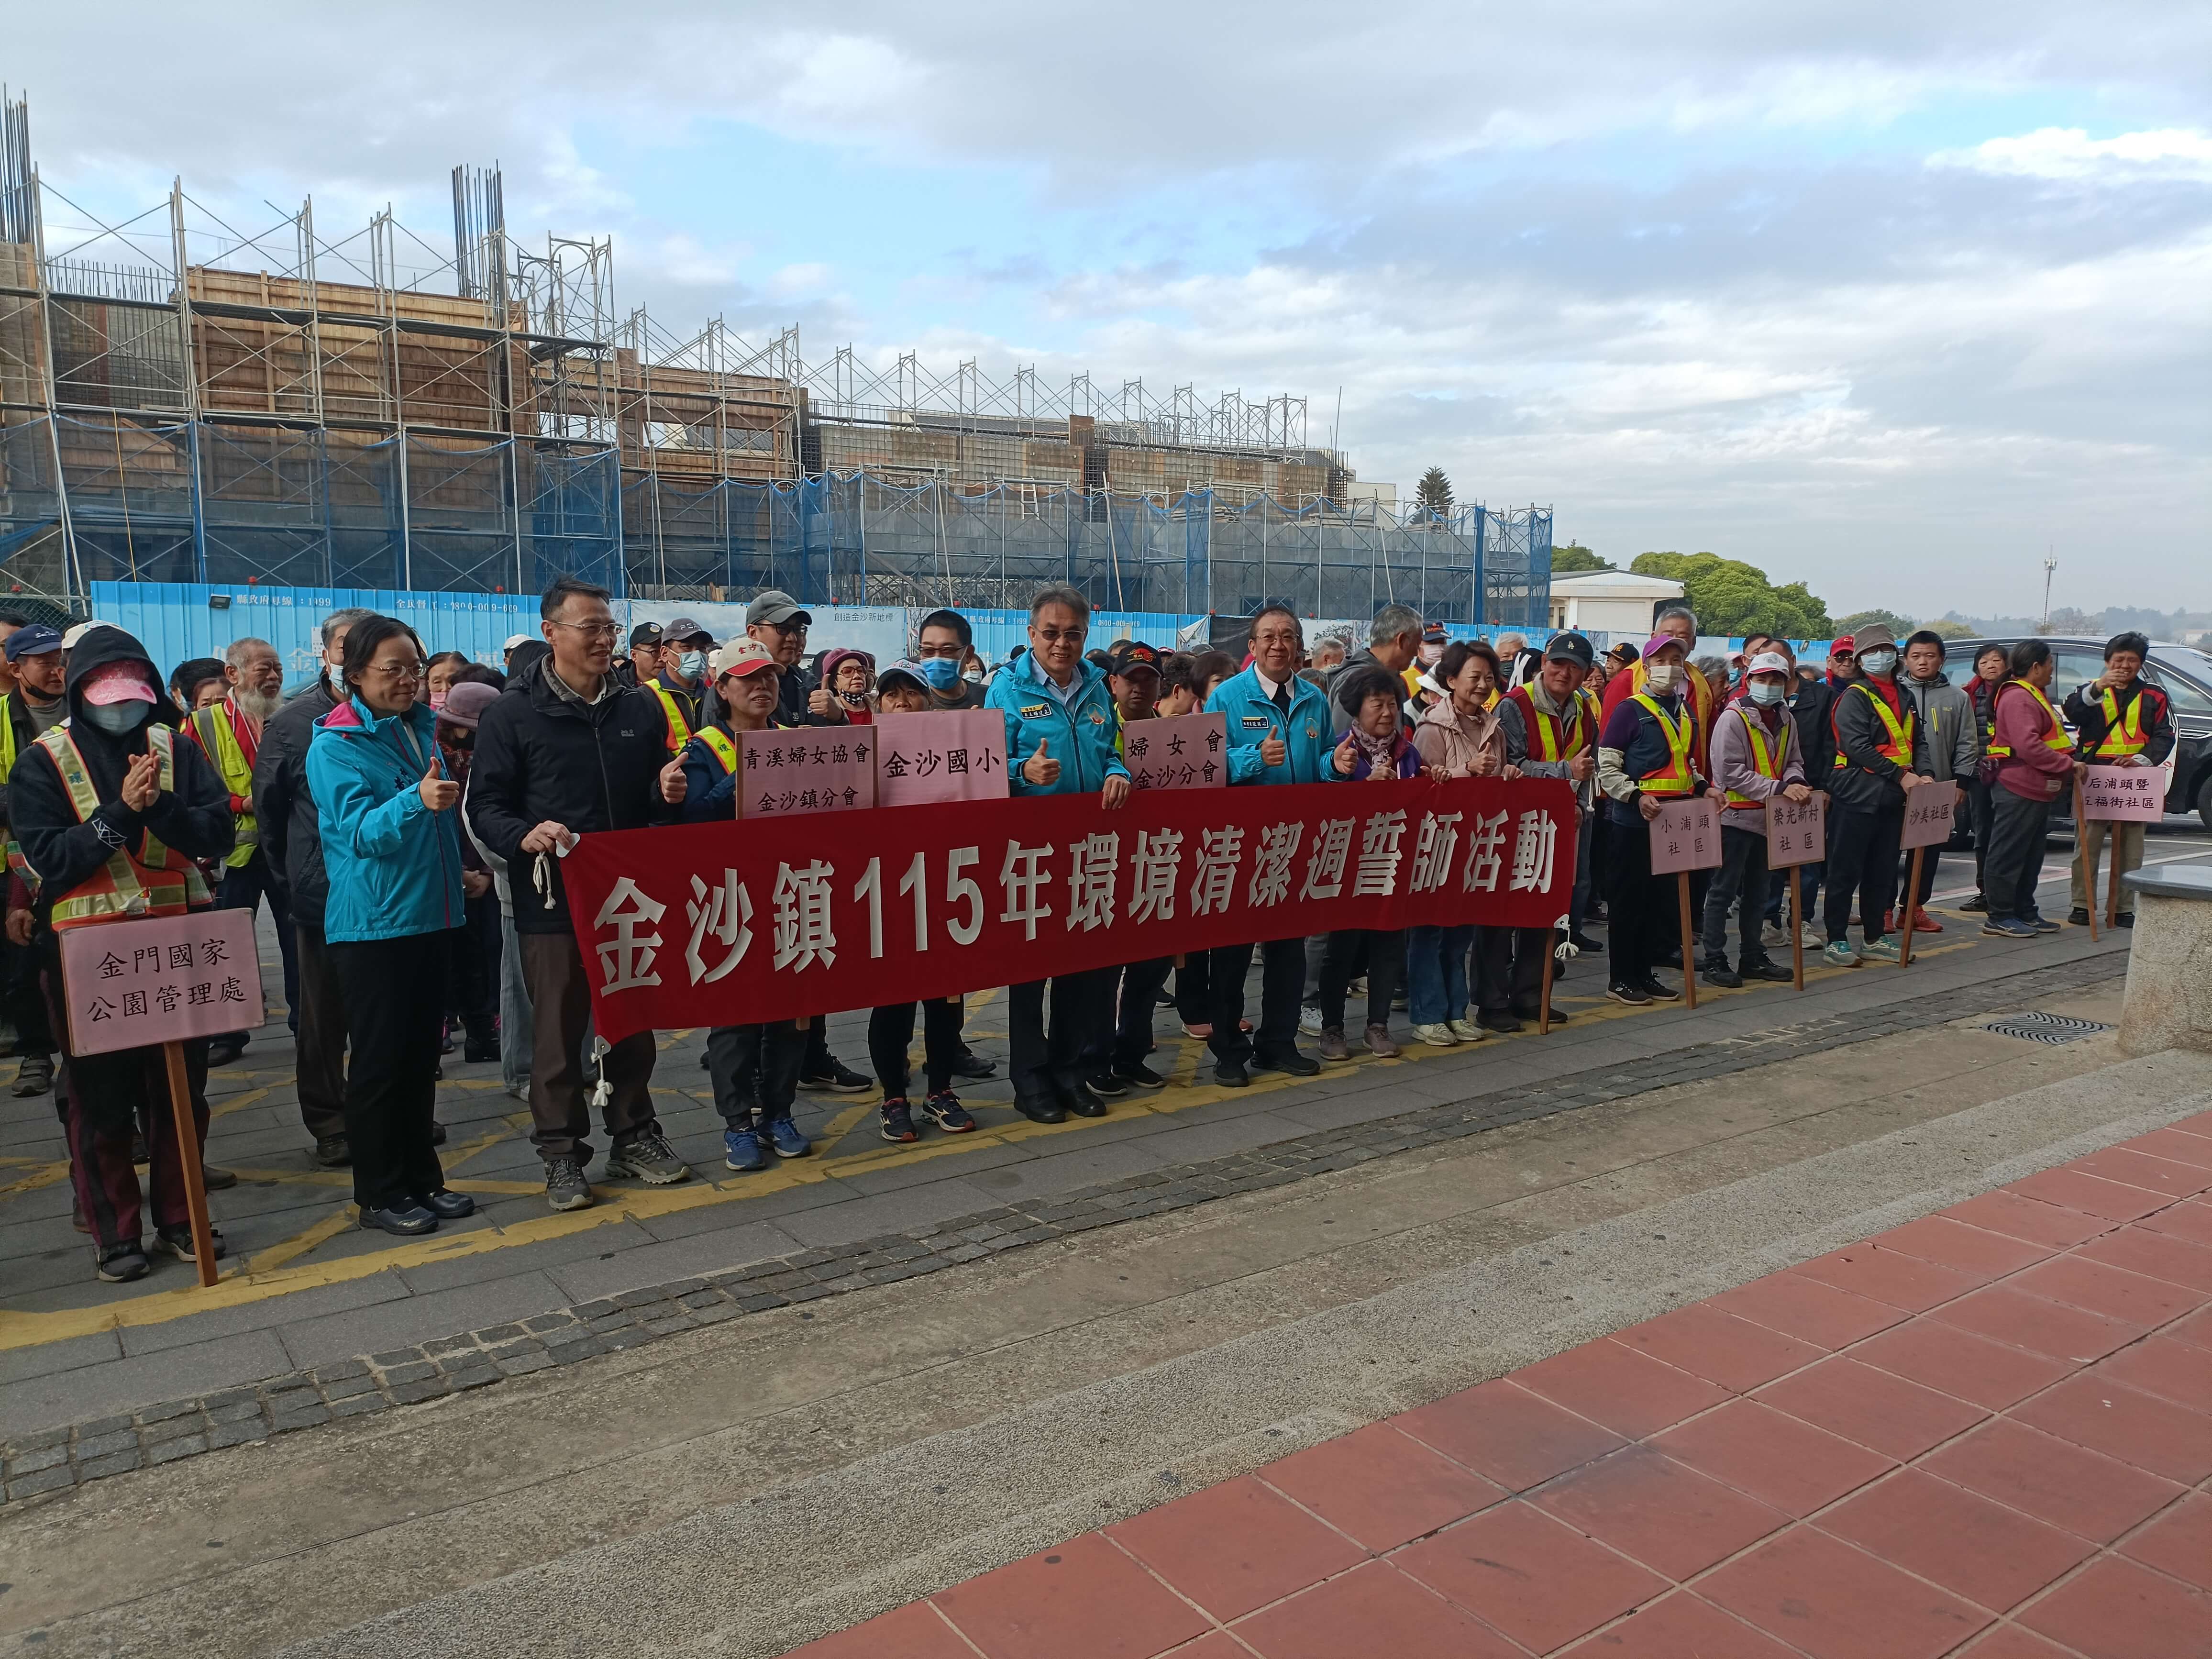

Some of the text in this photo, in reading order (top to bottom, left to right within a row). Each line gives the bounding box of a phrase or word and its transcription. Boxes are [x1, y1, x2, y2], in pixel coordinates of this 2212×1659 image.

[834, 612, 893, 622] 創造金沙新地標
[744, 742, 871, 770] 青溪婦女協會
[1128, 729, 1224, 761] 婦女會
[883, 747, 1000, 778] 金沙國小
[1134, 760, 1219, 790] 金沙分會
[2088, 777, 2149, 791] 后浦頭暨
[757, 785, 859, 812] 金沙鎮分會
[1661, 814, 1710, 833] 小浦頭
[1774, 804, 1819, 827] 榮光新村
[1909, 804, 1949, 825] 沙美社區
[1668, 838, 1703, 856] 社區
[1780, 832, 1814, 852] 社區
[594, 808, 1558, 998] 金沙鎮115年環境清潔週誓師活動
[96, 938, 231, 979] 金門國家
[87, 976, 249, 1022] 公園管理處
